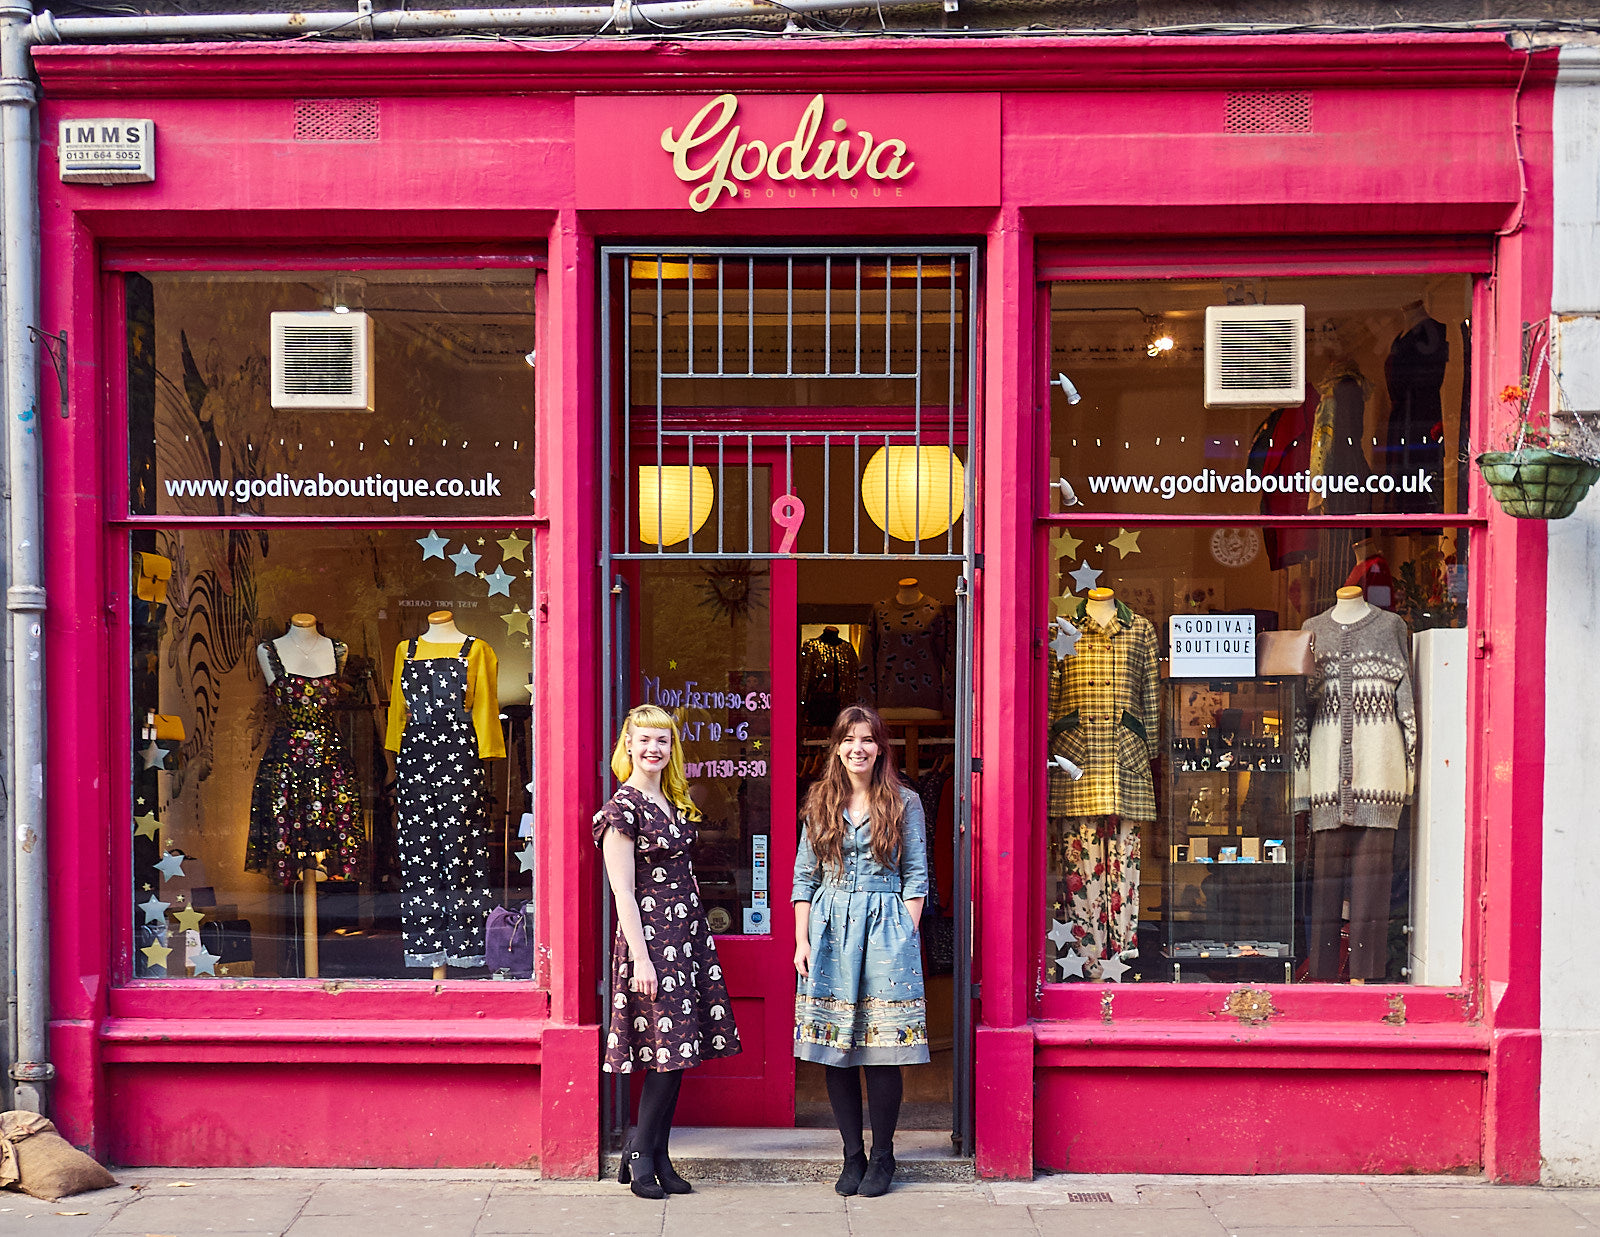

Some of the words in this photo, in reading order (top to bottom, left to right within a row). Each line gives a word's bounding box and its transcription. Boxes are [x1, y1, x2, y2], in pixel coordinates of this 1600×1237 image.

[65, 127, 140, 143] IMMS
[94, 151, 112, 159] 664
[661, 94, 915, 212] Godiva
[744, 187, 905, 199] BOUTIQUE
[164, 473, 502, 503] www.godivaboutique.co.uk
[1088, 468, 1433, 500] www.godivaboutique.co.uk
[772, 495, 805, 554] 9
[1185, 620, 1242, 633] GODIVA
[1176, 640, 1250, 653] BOUTIQUE
[685, 763, 704, 778] UN
